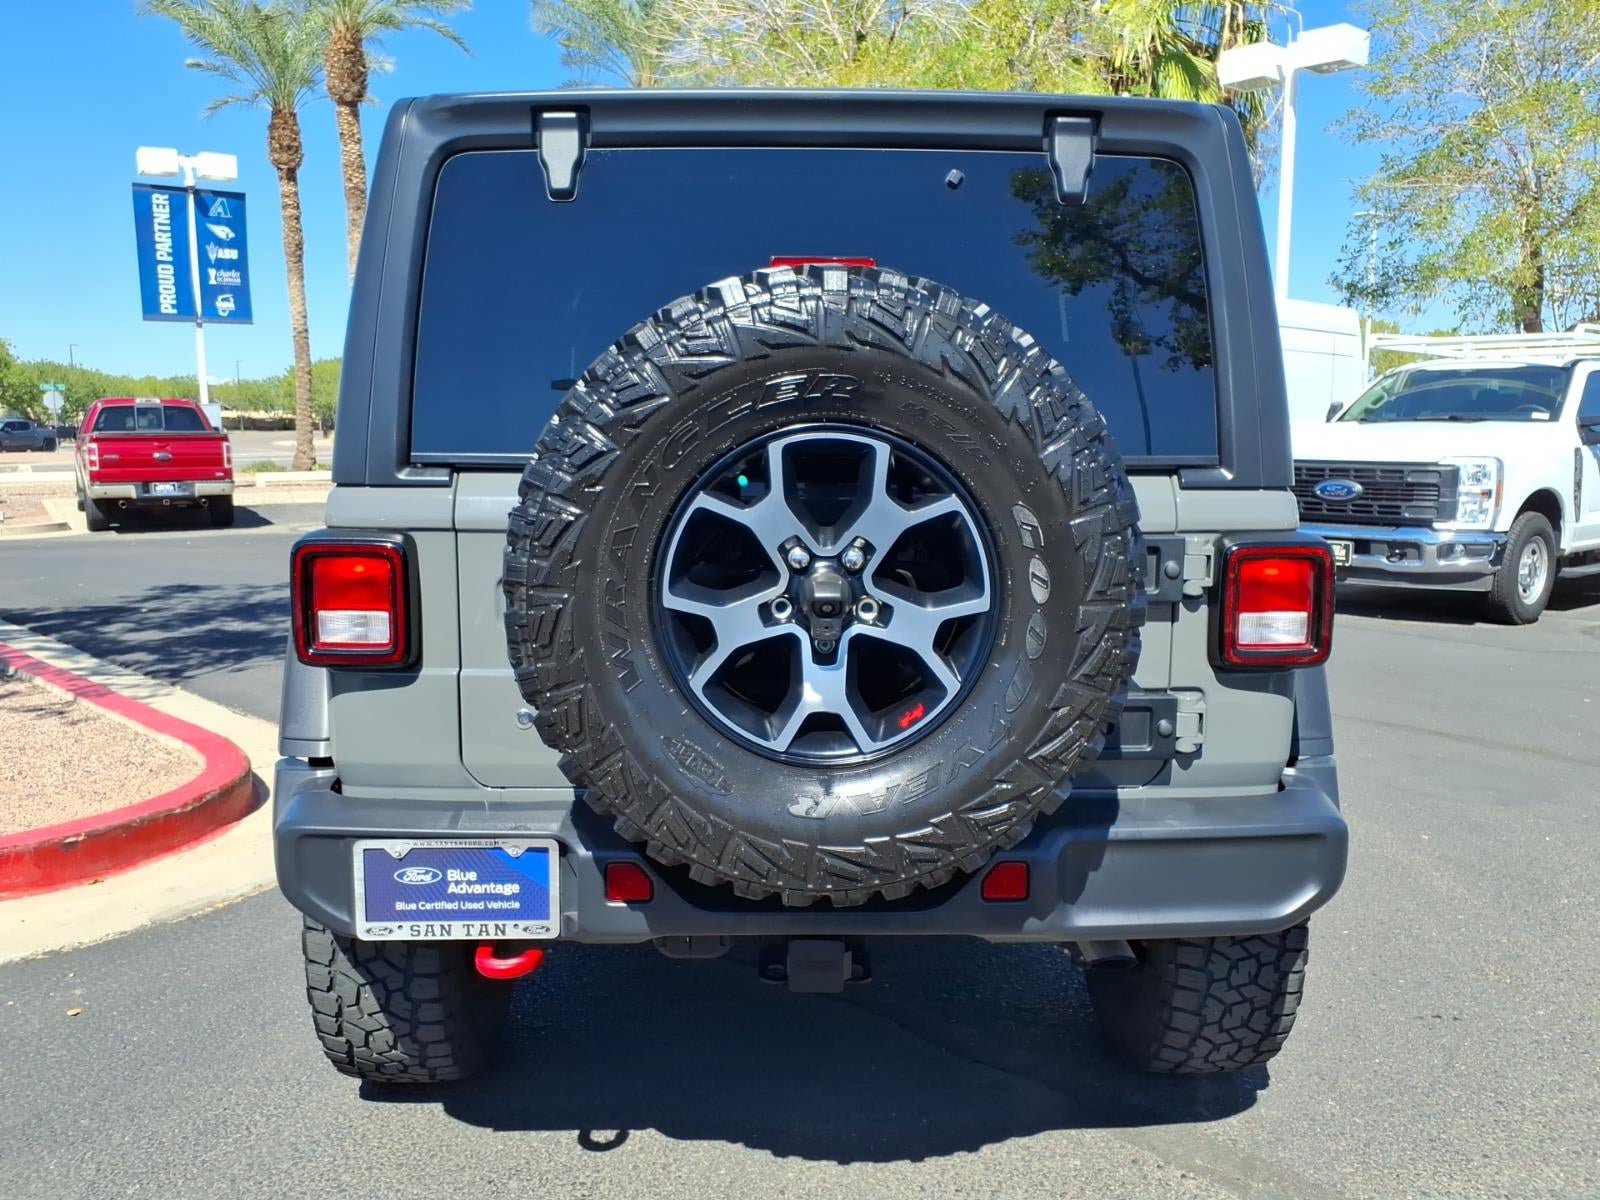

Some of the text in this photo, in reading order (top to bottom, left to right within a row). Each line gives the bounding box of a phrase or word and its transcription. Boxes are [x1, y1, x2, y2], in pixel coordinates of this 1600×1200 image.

[152, 193, 178, 314] PROUD PARTNER
[603, 372, 860, 695] WRANGLER
[403, 869, 433, 882] Ford
[447, 869, 477, 881] Blue
[447, 882, 520, 895] Advantage
[396, 901, 520, 911] Blue Certified Used Vehicle
[410, 924, 507, 937] SAN TAN
